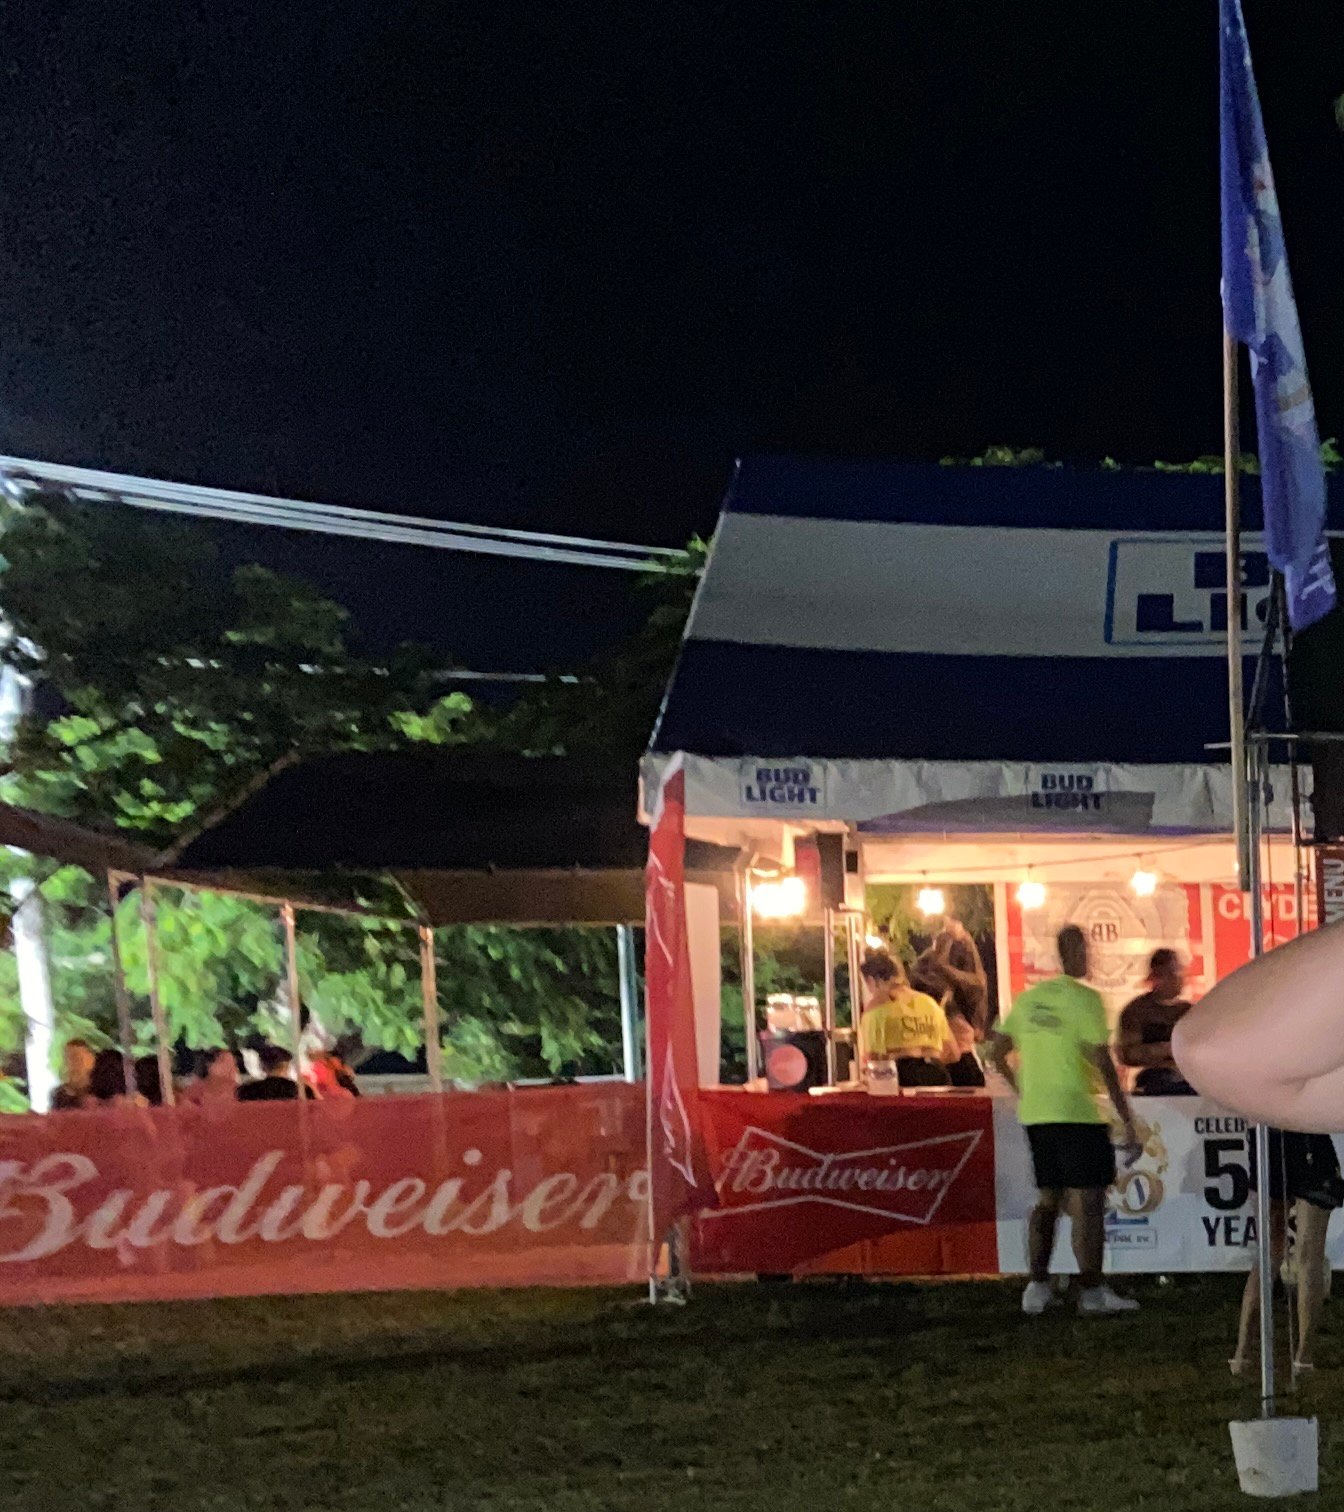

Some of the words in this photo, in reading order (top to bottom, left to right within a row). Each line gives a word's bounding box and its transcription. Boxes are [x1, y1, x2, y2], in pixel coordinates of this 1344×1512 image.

[1041, 774, 1093, 791] BUD
[721, 1147, 955, 1193] Budweiser
[1203, 1138, 1250, 1211] 5
[0, 1150, 651, 1262] Budweiser
[1202, 1215, 1259, 1248] YEA
